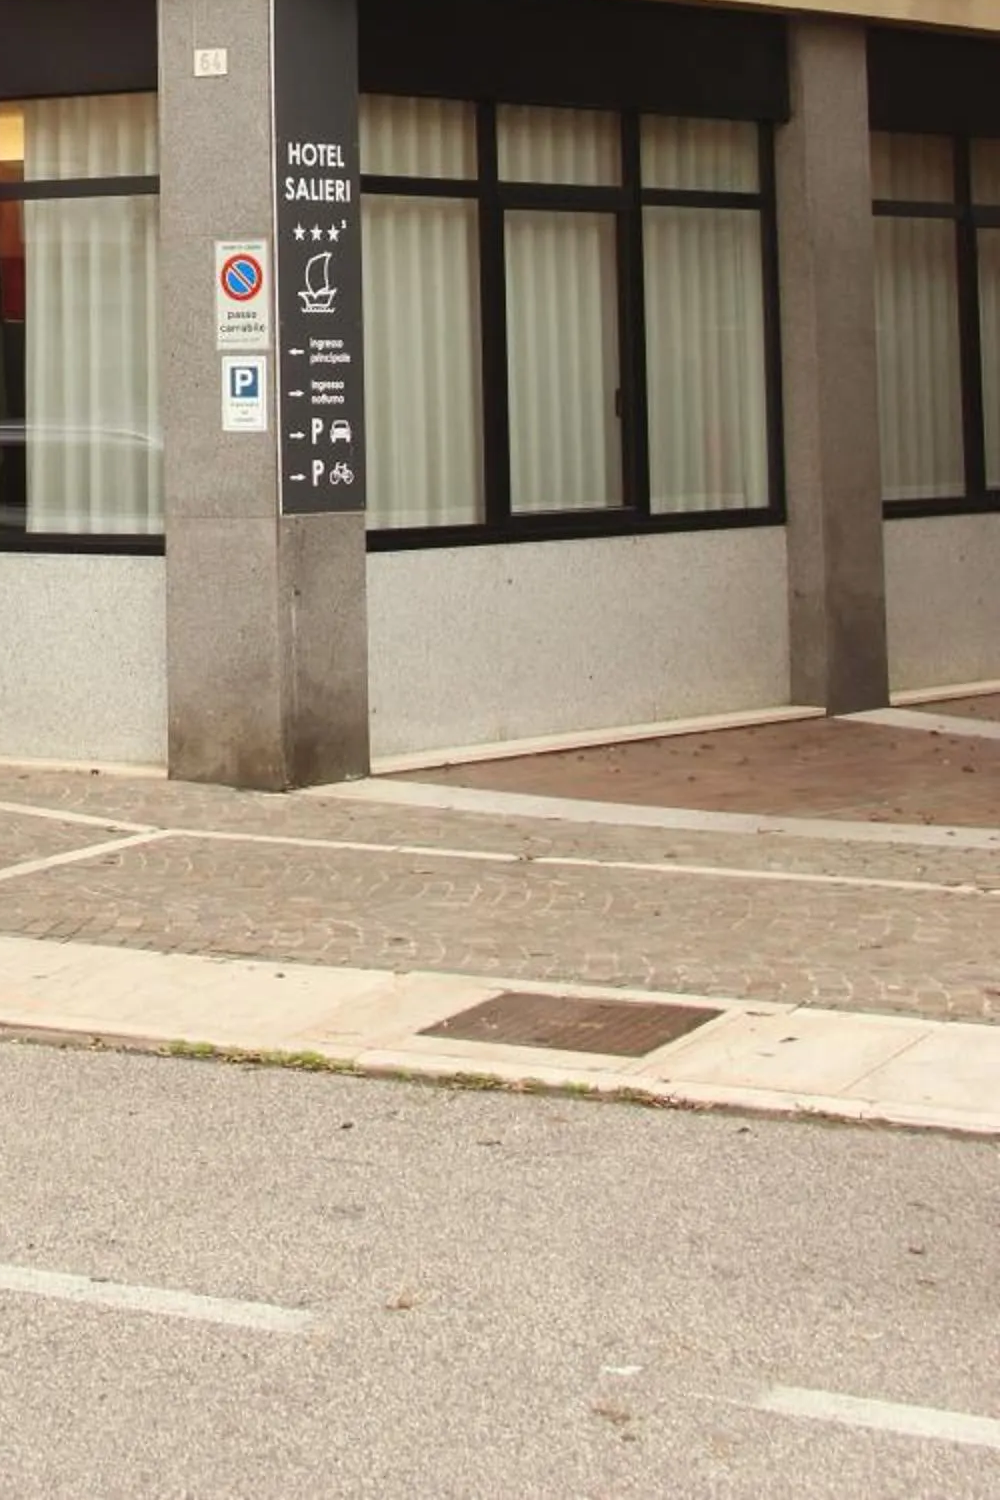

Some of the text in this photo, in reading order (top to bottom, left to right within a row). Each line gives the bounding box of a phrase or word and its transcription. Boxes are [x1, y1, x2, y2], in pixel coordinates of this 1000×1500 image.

[200, 51, 222, 71] 64
[287, 142, 345, 167] HOTEL
[285, 176, 351, 202] SALIERI
[227, 311, 257, 320] passo
[235, 369, 253, 396] P
[312, 417, 323, 444] P
[313, 460, 324, 487] P
